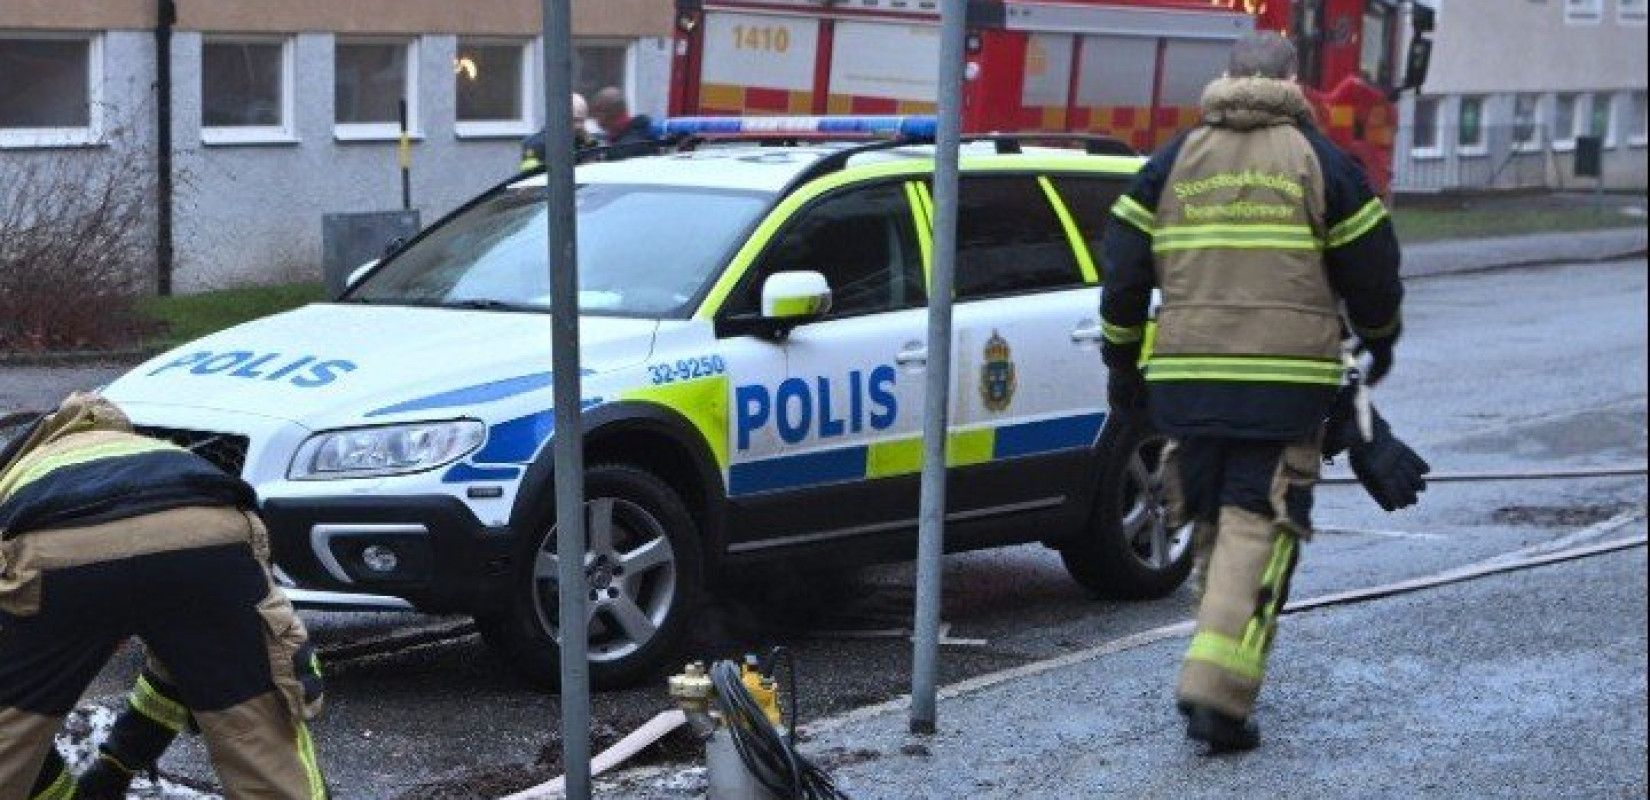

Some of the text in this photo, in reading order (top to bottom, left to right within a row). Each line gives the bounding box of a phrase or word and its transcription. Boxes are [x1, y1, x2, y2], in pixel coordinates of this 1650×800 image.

[733, 24, 789, 52] 1410
[147, 350, 358, 388] POLIS
[648, 354, 725, 385] 32-9250
[735, 364, 898, 452] POLIS
